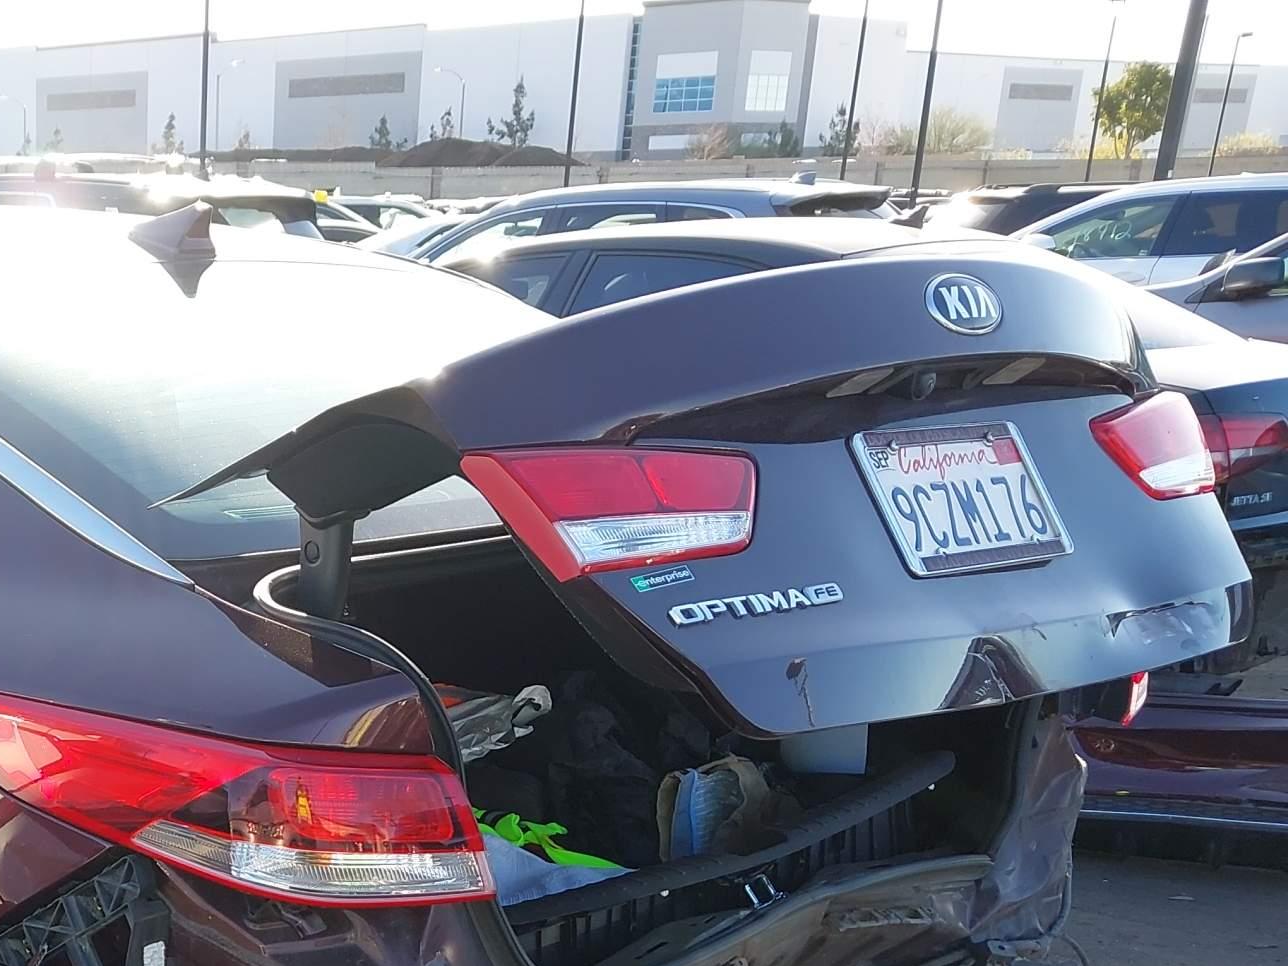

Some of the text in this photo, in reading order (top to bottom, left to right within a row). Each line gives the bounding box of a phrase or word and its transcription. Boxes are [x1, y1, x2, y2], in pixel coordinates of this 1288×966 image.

[938, 285, 997, 320] KIA
[869, 450, 890, 469] SEP
[898, 443, 997, 480] California
[891, 474, 1048, 551] 9CZM176
[1231, 494, 1260, 506] JETTA
[636, 569, 691, 590] enterprise
[669, 585, 839, 627] OPTIMA FE
